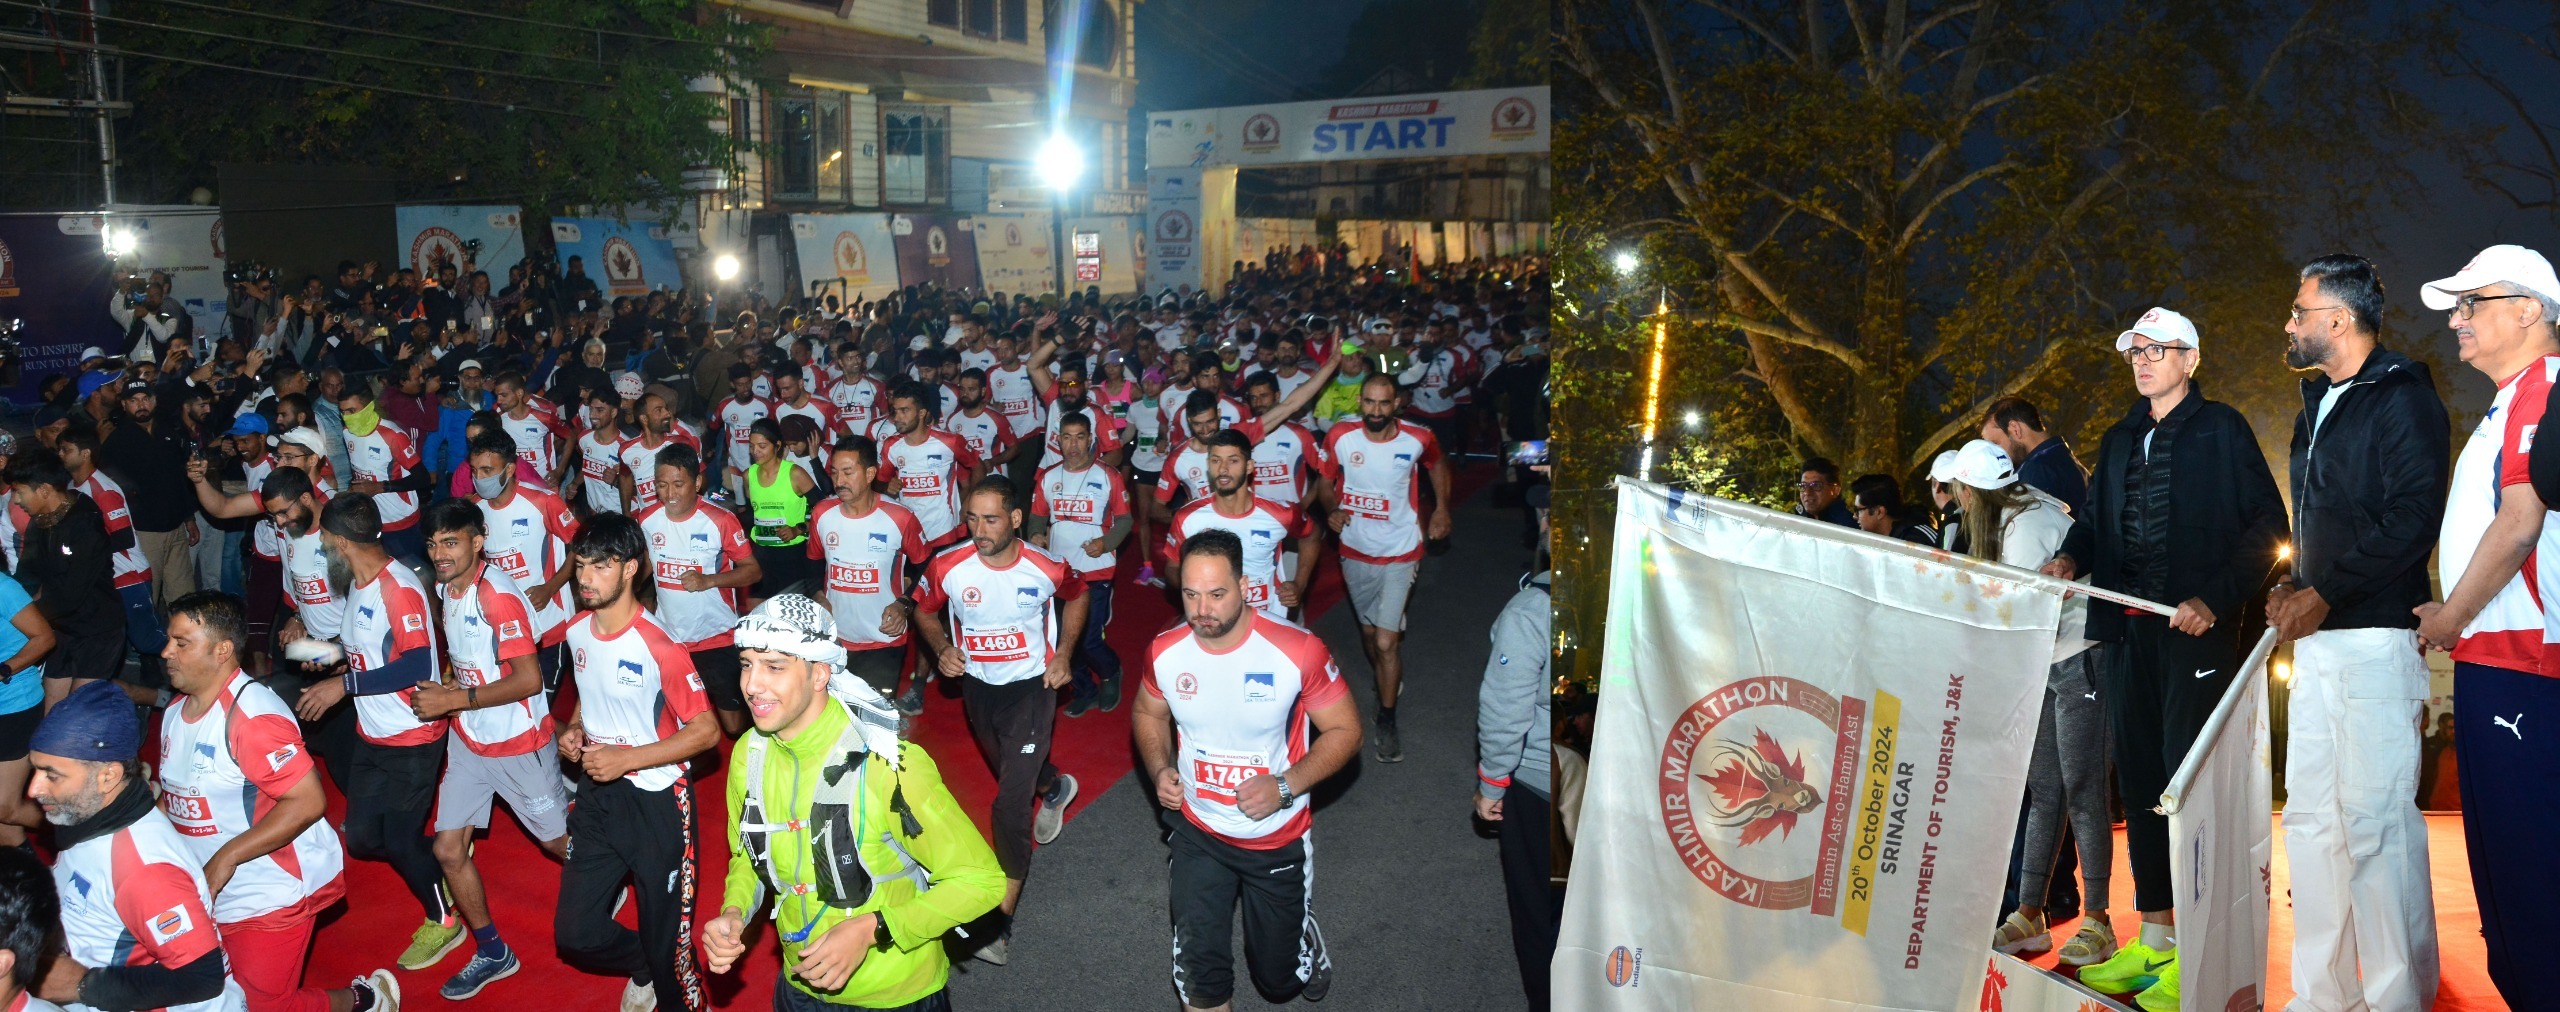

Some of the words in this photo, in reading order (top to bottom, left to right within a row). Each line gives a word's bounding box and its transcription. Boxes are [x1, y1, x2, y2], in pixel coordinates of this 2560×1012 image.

[1335, 105, 1377, 118] KASHMIR
[1378, 102, 1430, 116] MARATHON
[1312, 116, 1456, 153] START
[411, 229, 432, 264] KASHMIR
[25, 359, 48, 371] RUN
[49, 359, 65, 369] TO
[1004, 401, 1025, 411] 1279
[905, 477, 935, 490] 1356
[1253, 466, 1284, 477] 1676
[1058, 500, 1088, 513] 1720
[1348, 495, 1384, 511] 1165
[836, 567, 873, 584] 1619
[1244, 587, 1266, 602] 92
[972, 635, 1019, 651] 1460
[1945, 673, 1965, 711] J&K
[1665, 680, 1788, 782] MARATHON
[1843, 714, 1859, 741] Ast
[1872, 726, 1893, 776] 2024
[1931, 715, 1961, 806] TOURISM,
[167, 793, 202, 819] 1683
[1827, 744, 1855, 843] Ast-o-Hamin
[1857, 779, 1885, 861] October
[1880, 762, 1915, 875] SRINAGAR
[1926, 810, 1943, 838] OF
[1665, 793, 1759, 902] KASHMIR
[1818, 847, 1838, 899] Hamin
[1851, 865, 1869, 901] 20th
[1904, 841, 1938, 970] DEPARTMENT
[1631, 947, 1643, 987] IndianOil
